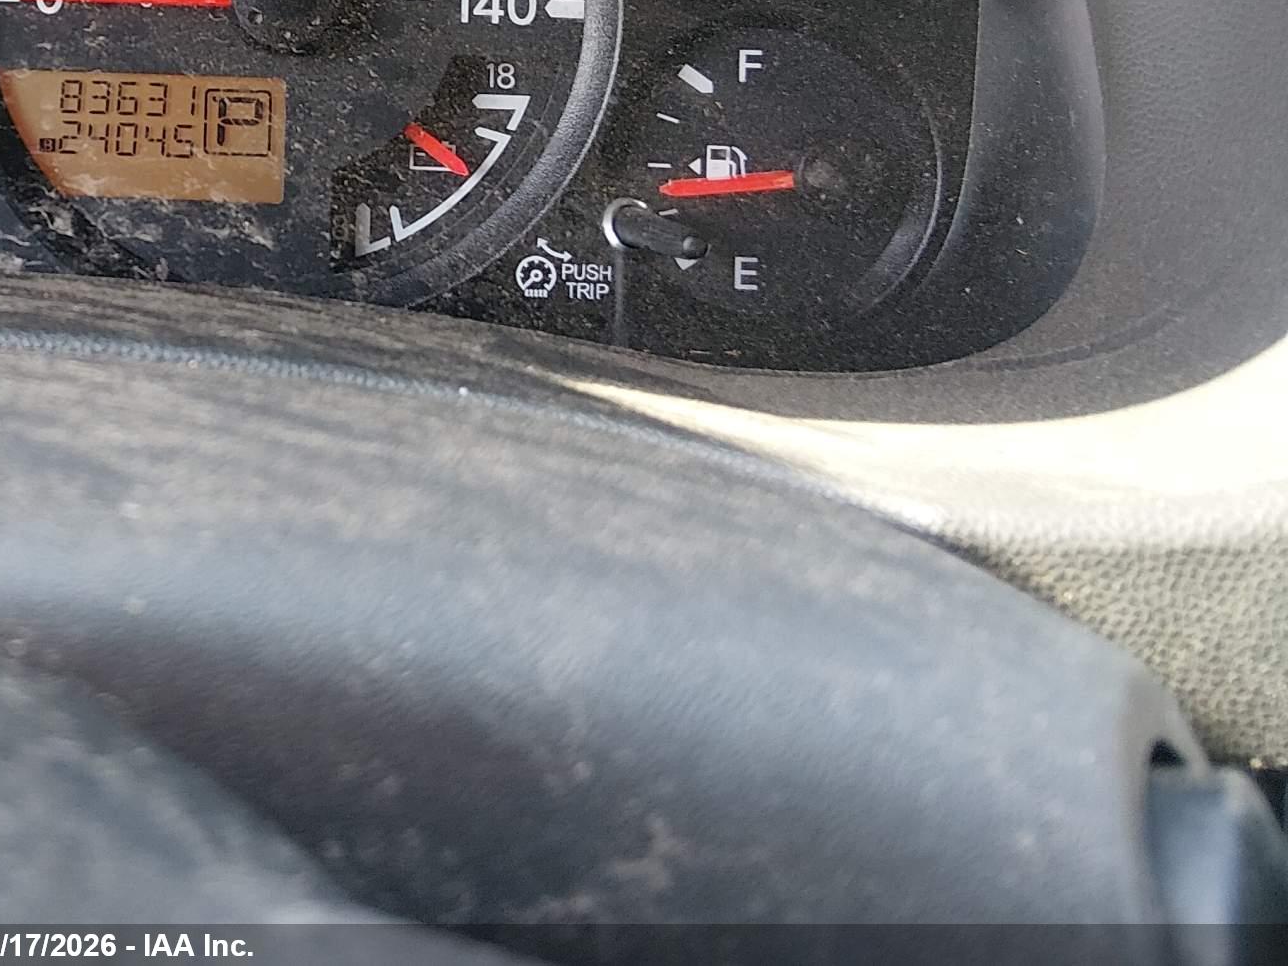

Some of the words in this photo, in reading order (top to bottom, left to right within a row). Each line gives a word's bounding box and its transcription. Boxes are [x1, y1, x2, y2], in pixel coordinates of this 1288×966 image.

[487, 64, 515, 89] 18
[739, 50, 762, 82] F
[60, 79, 197, 116] 83631
[218, 96, 263, 146] P
[562, 264, 611, 281] PUSH
[735, 257, 758, 290] E
[566, 282, 609, 299] TRIP
